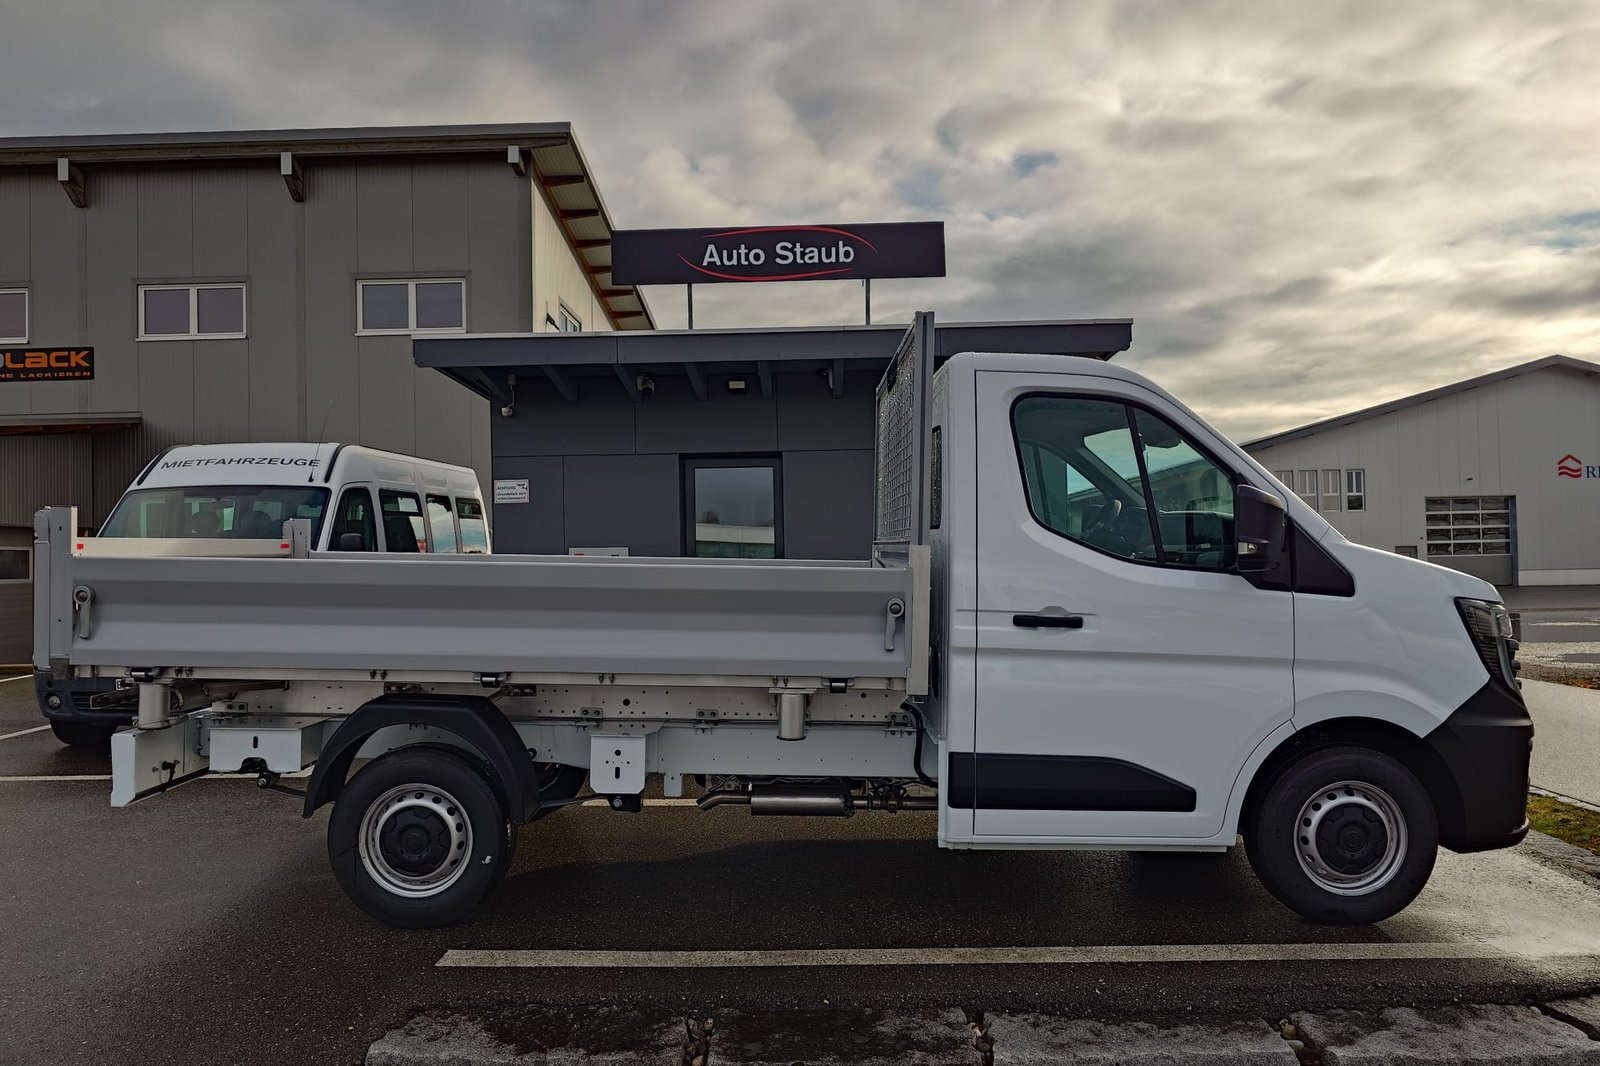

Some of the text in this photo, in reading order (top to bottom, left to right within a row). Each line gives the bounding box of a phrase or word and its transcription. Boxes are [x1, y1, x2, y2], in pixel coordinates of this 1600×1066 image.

[702, 240, 855, 266] Auto Staub
[20, 371, 91, 379] LACKIEREN
[161, 457, 321, 470] MIETFAHRZEUGE
[1585, 465, 1600, 479] R
